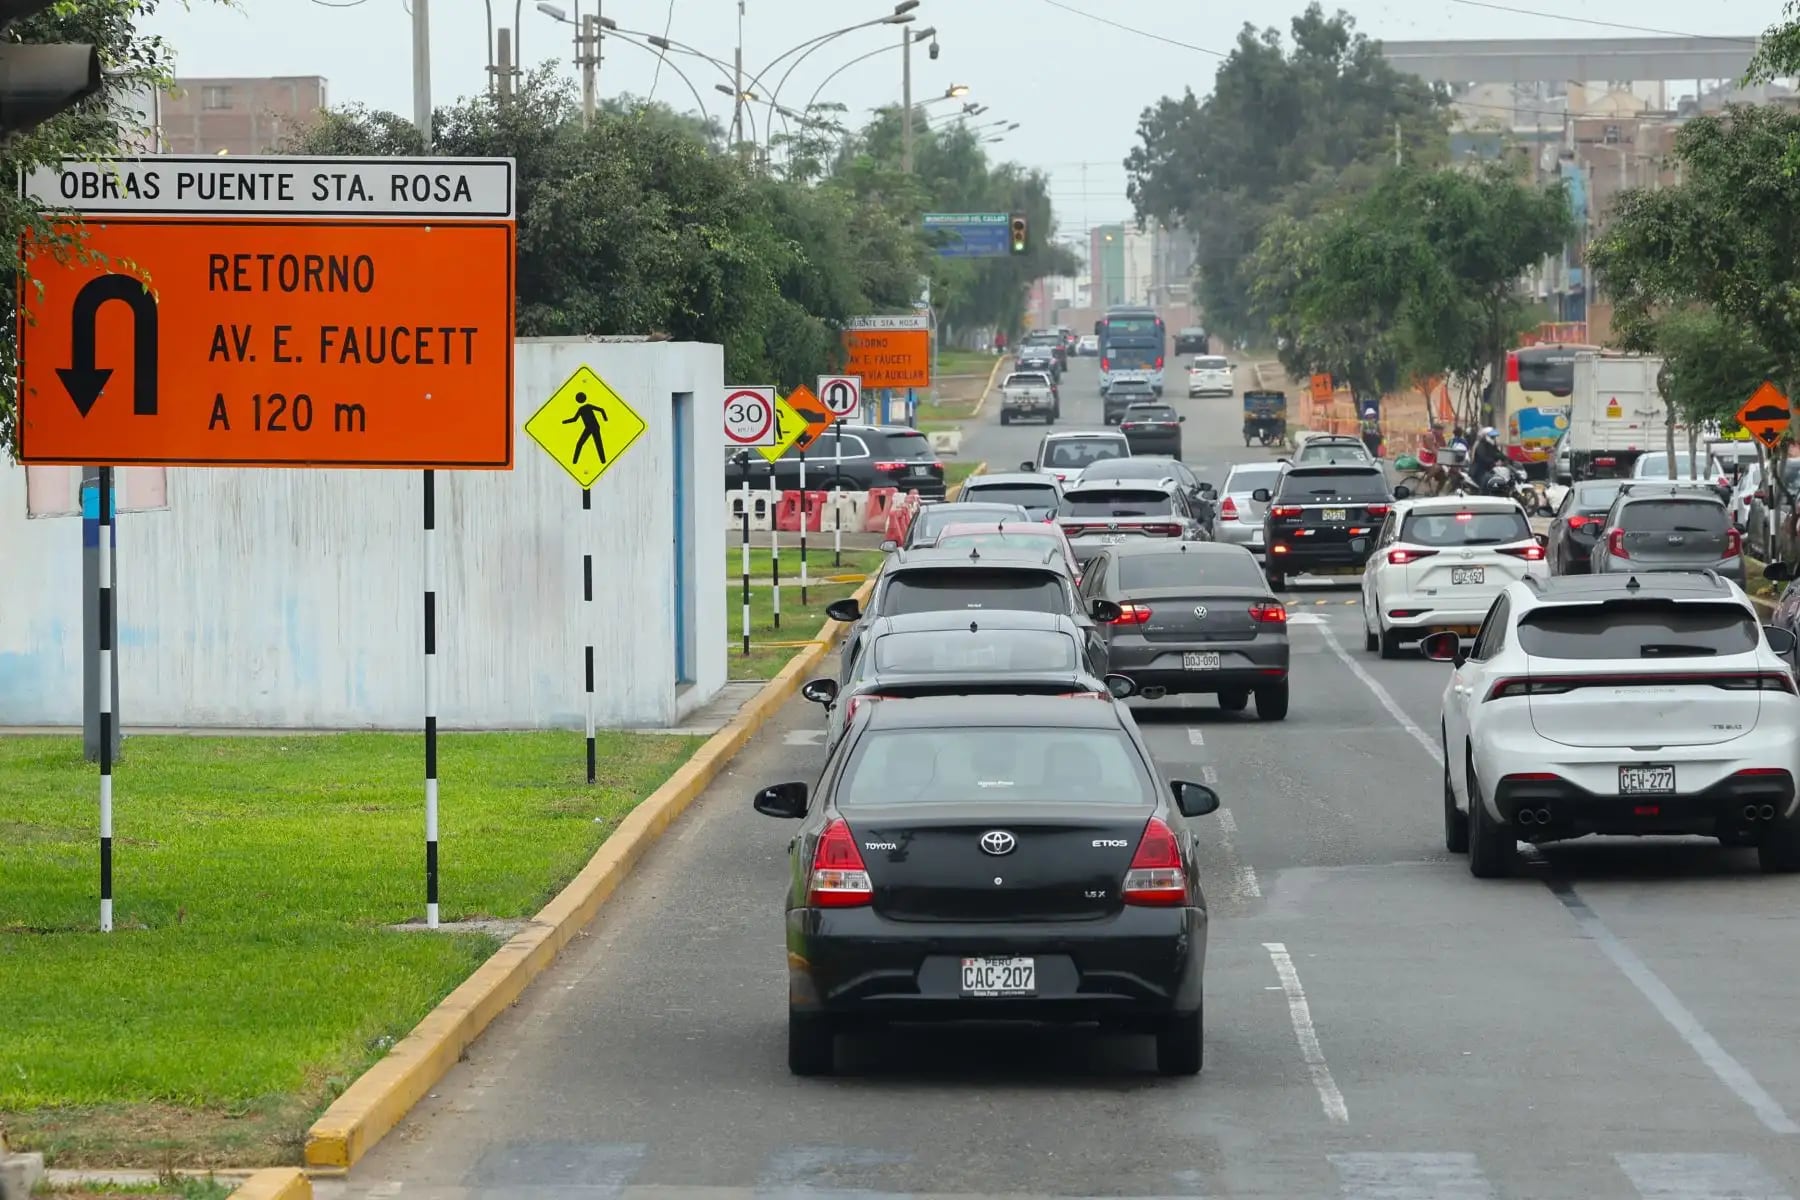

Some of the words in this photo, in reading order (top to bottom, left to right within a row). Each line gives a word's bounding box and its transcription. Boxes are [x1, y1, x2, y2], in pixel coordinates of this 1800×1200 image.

[60, 171, 160, 200] OBRAS
[178, 172, 293, 201] PUENTE
[312, 173, 374, 202] STA.
[391, 174, 472, 203] ROSA
[208, 253, 375, 293] RETORNO
[208, 324, 256, 363] AV.
[273, 325, 303, 364] E.
[320, 326, 478, 366] FAUCETT
[875, 354, 912, 365] FAUCETT
[207, 393, 231, 431] A
[252, 393, 313, 432] 120
[334, 403, 366, 432] m
[728, 403, 763, 424] 30
[1622, 773, 1673, 789] CEW-277
[864, 842, 897, 850] TOYOTA
[1091, 839, 1129, 848] ETIOS
[963, 966, 1034, 989] CAC-207
